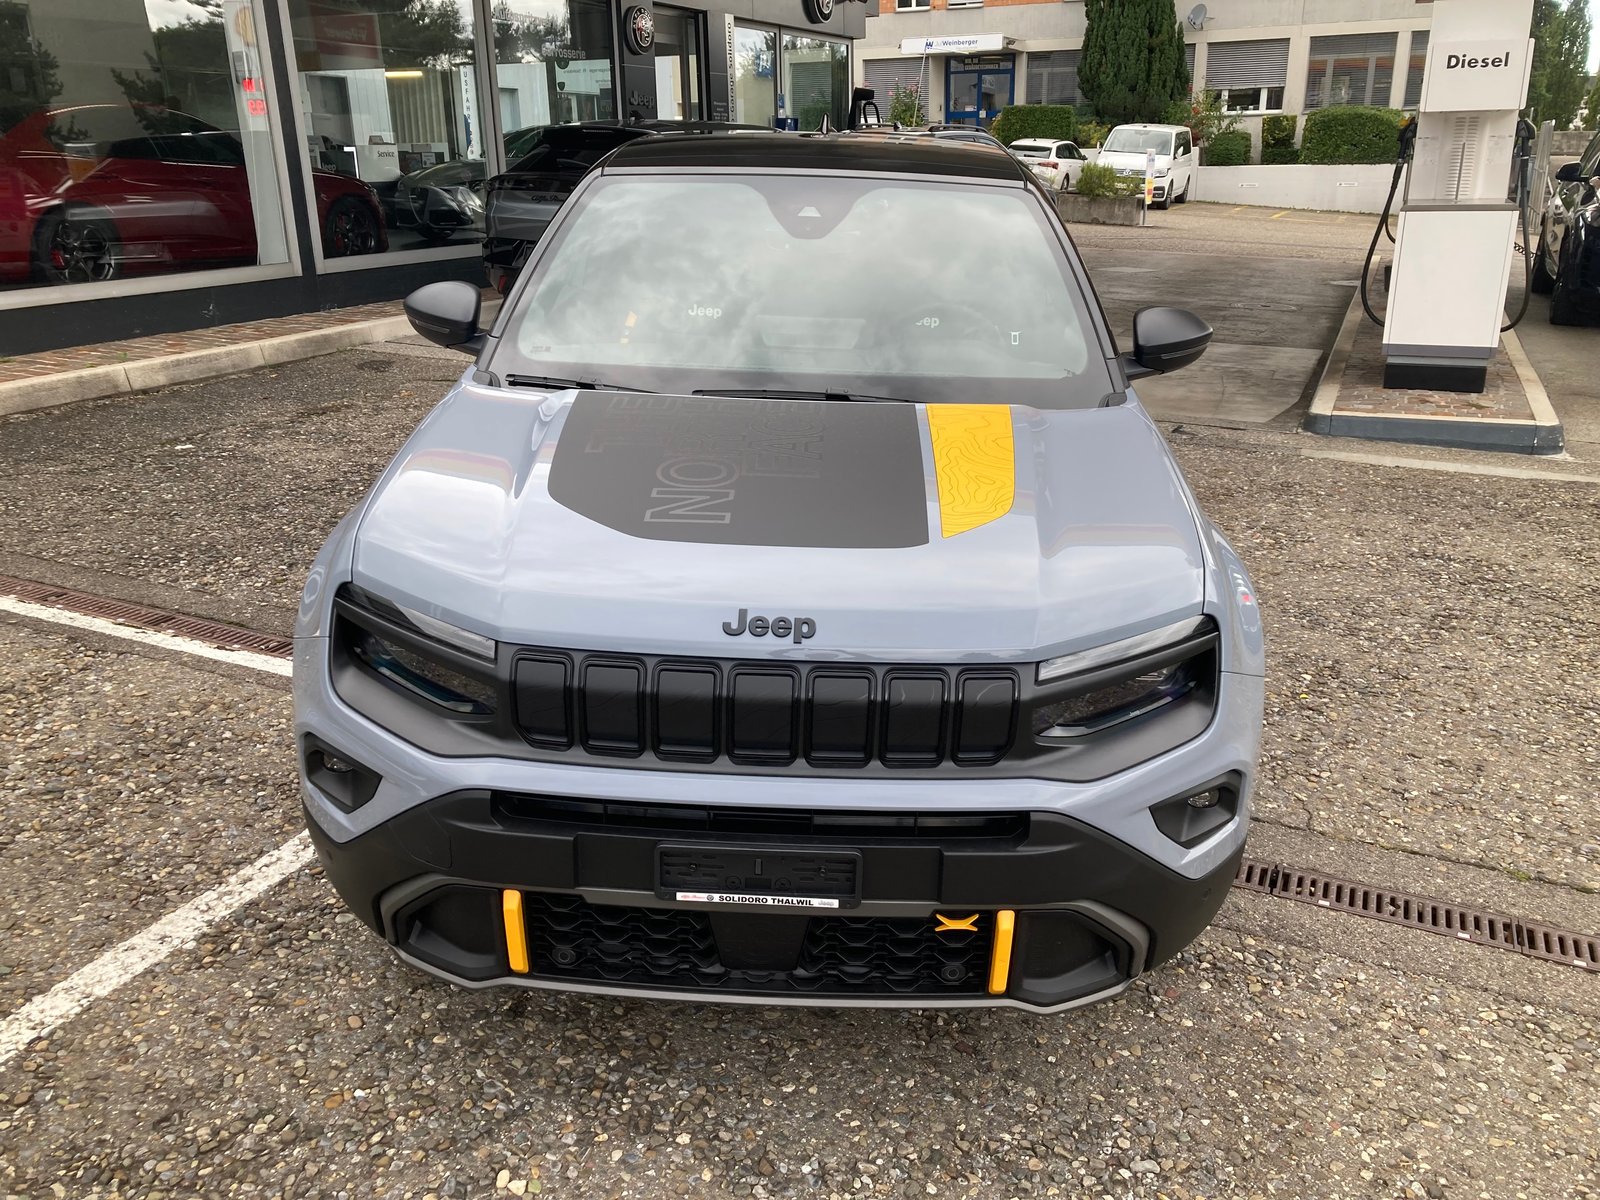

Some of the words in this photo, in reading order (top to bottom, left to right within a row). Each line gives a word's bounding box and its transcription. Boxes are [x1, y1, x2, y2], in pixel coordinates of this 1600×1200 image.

[1447, 51, 1510, 69] Diesel
[630, 90, 655, 109] Jeep
[377, 150, 395, 158] Service
[688, 303, 722, 320] Jeep
[722, 608, 817, 645] Jeep
[718, 895, 768, 904] SOLIDORO
[771, 897, 814, 906] THALWIL
